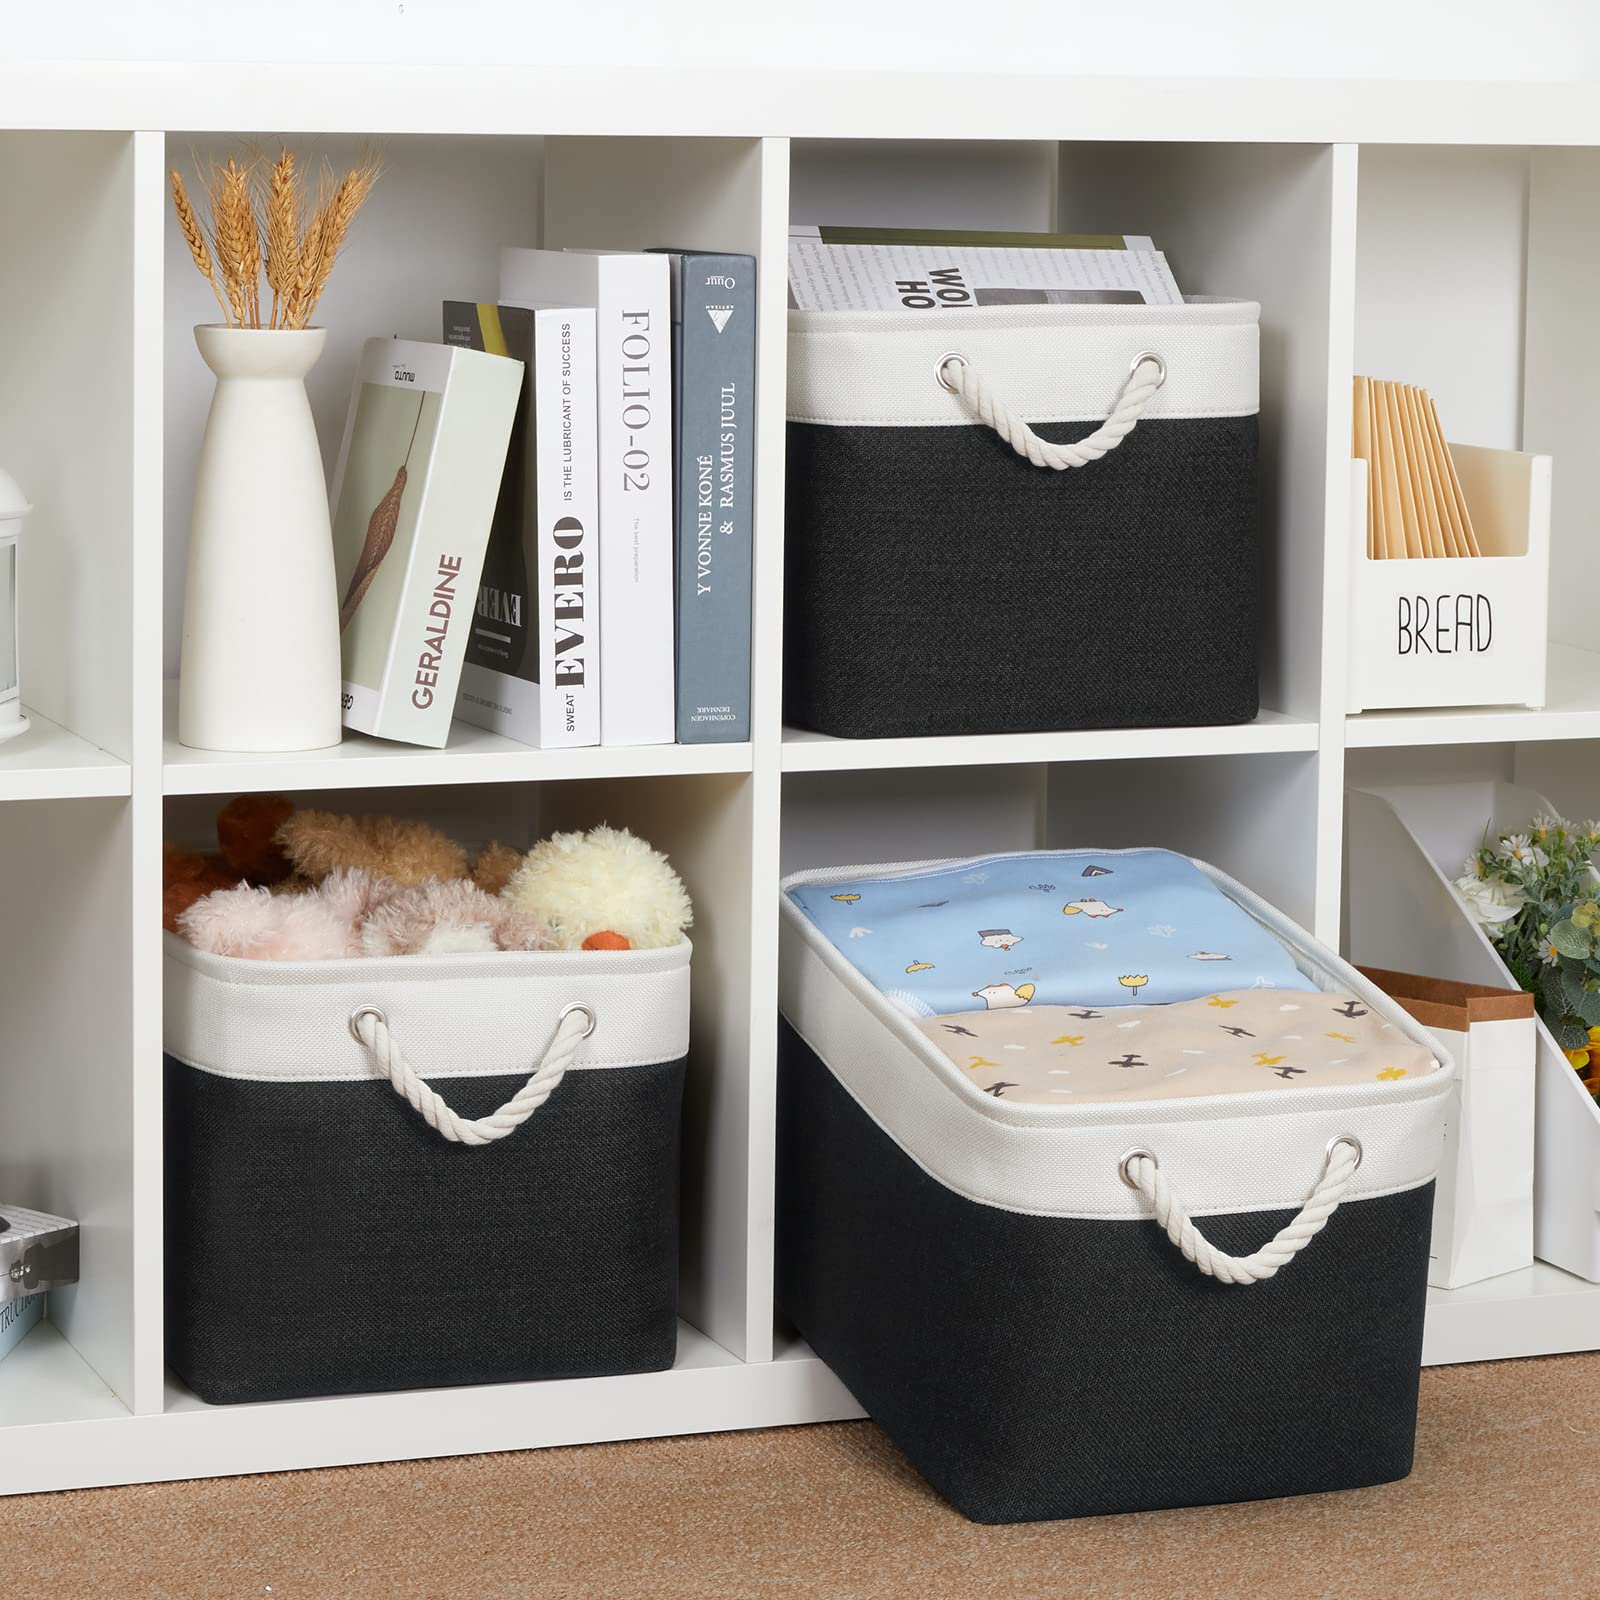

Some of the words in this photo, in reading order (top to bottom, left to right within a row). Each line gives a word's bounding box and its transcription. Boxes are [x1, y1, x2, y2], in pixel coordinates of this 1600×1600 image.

[929, 268, 973, 308] WO
[561, 323, 572, 377] SUCCESS
[562, 379, 572, 396] OF
[622, 310, 651, 492] FOLIO-02
[719, 382, 736, 429] JUUL
[562, 397, 572, 463] LUBRICANT
[562, 465, 573, 488] THE
[696, 454, 713, 508] KONÉ
[719, 432, 735, 508] RASMUS
[562, 490, 573, 501] IS
[719, 520, 734, 535] &
[552, 516, 585, 690] EVERO
[1398, 593, 1493, 655] BREAD
[411, 554, 462, 710] GERALDINE
[565, 693, 576, 732] SWEAT
[690, 714, 736, 722] COPENHAGEN
